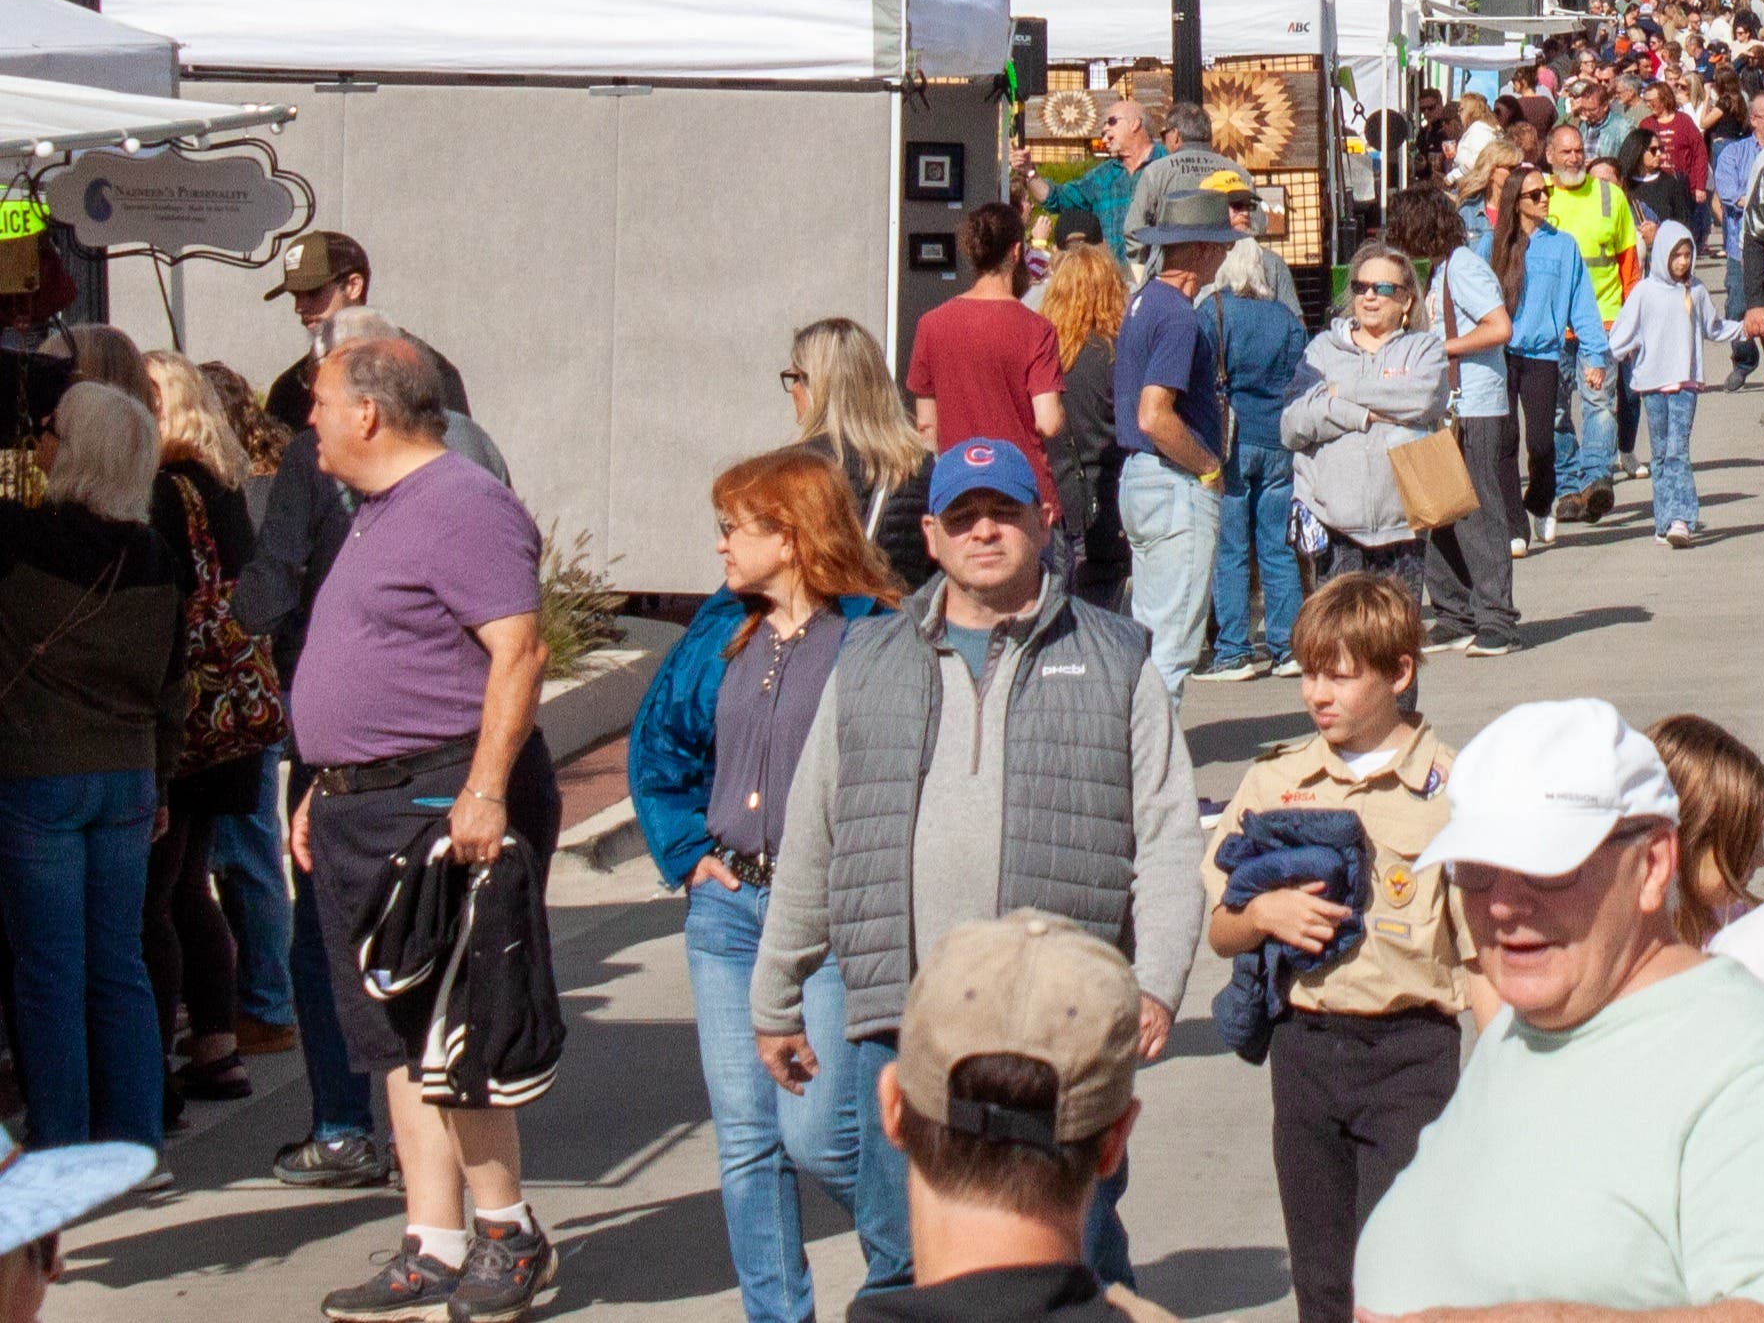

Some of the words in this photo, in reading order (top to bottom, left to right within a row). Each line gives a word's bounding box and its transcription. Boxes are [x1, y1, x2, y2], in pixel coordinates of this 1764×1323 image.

[1287, 21, 1311, 33] ABC
[0, 210, 31, 233] ICE
[965, 444, 994, 466] C
